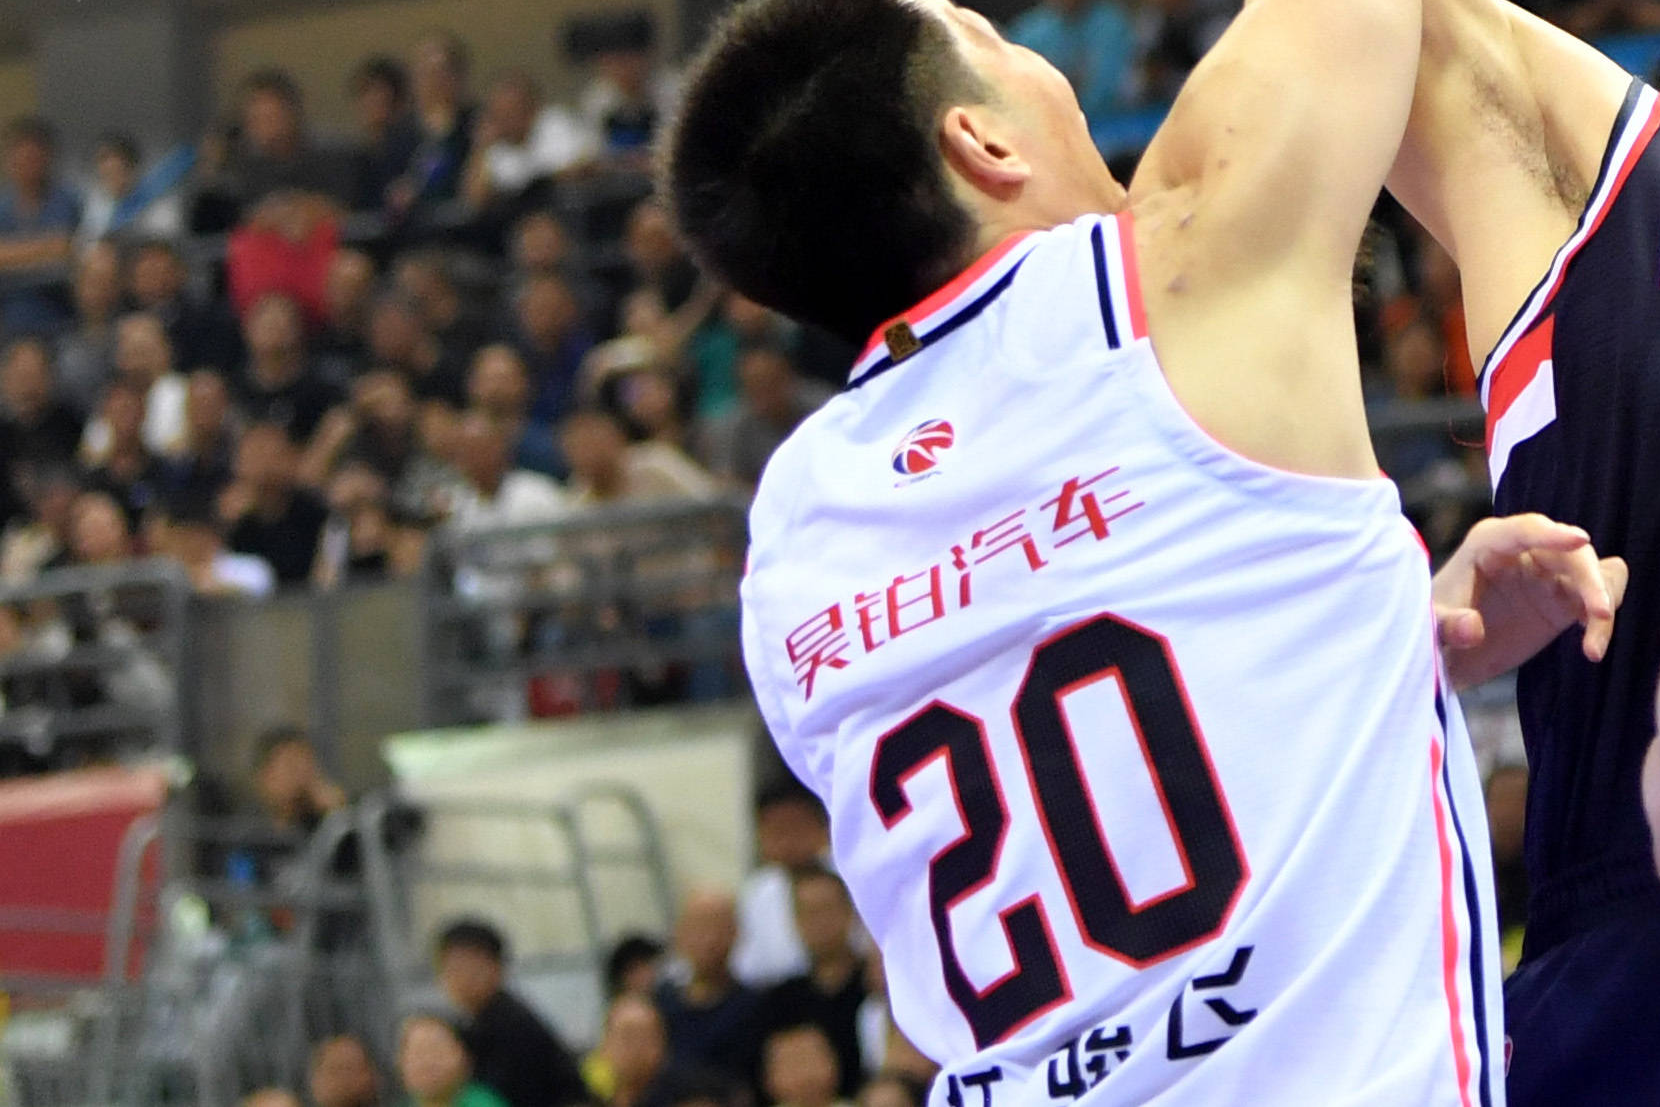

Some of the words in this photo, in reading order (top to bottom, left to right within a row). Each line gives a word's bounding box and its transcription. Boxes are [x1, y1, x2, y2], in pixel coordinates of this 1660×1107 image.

[785, 466, 1146, 702] 昊铂汽车
[869, 611, 1251, 1052] 20
